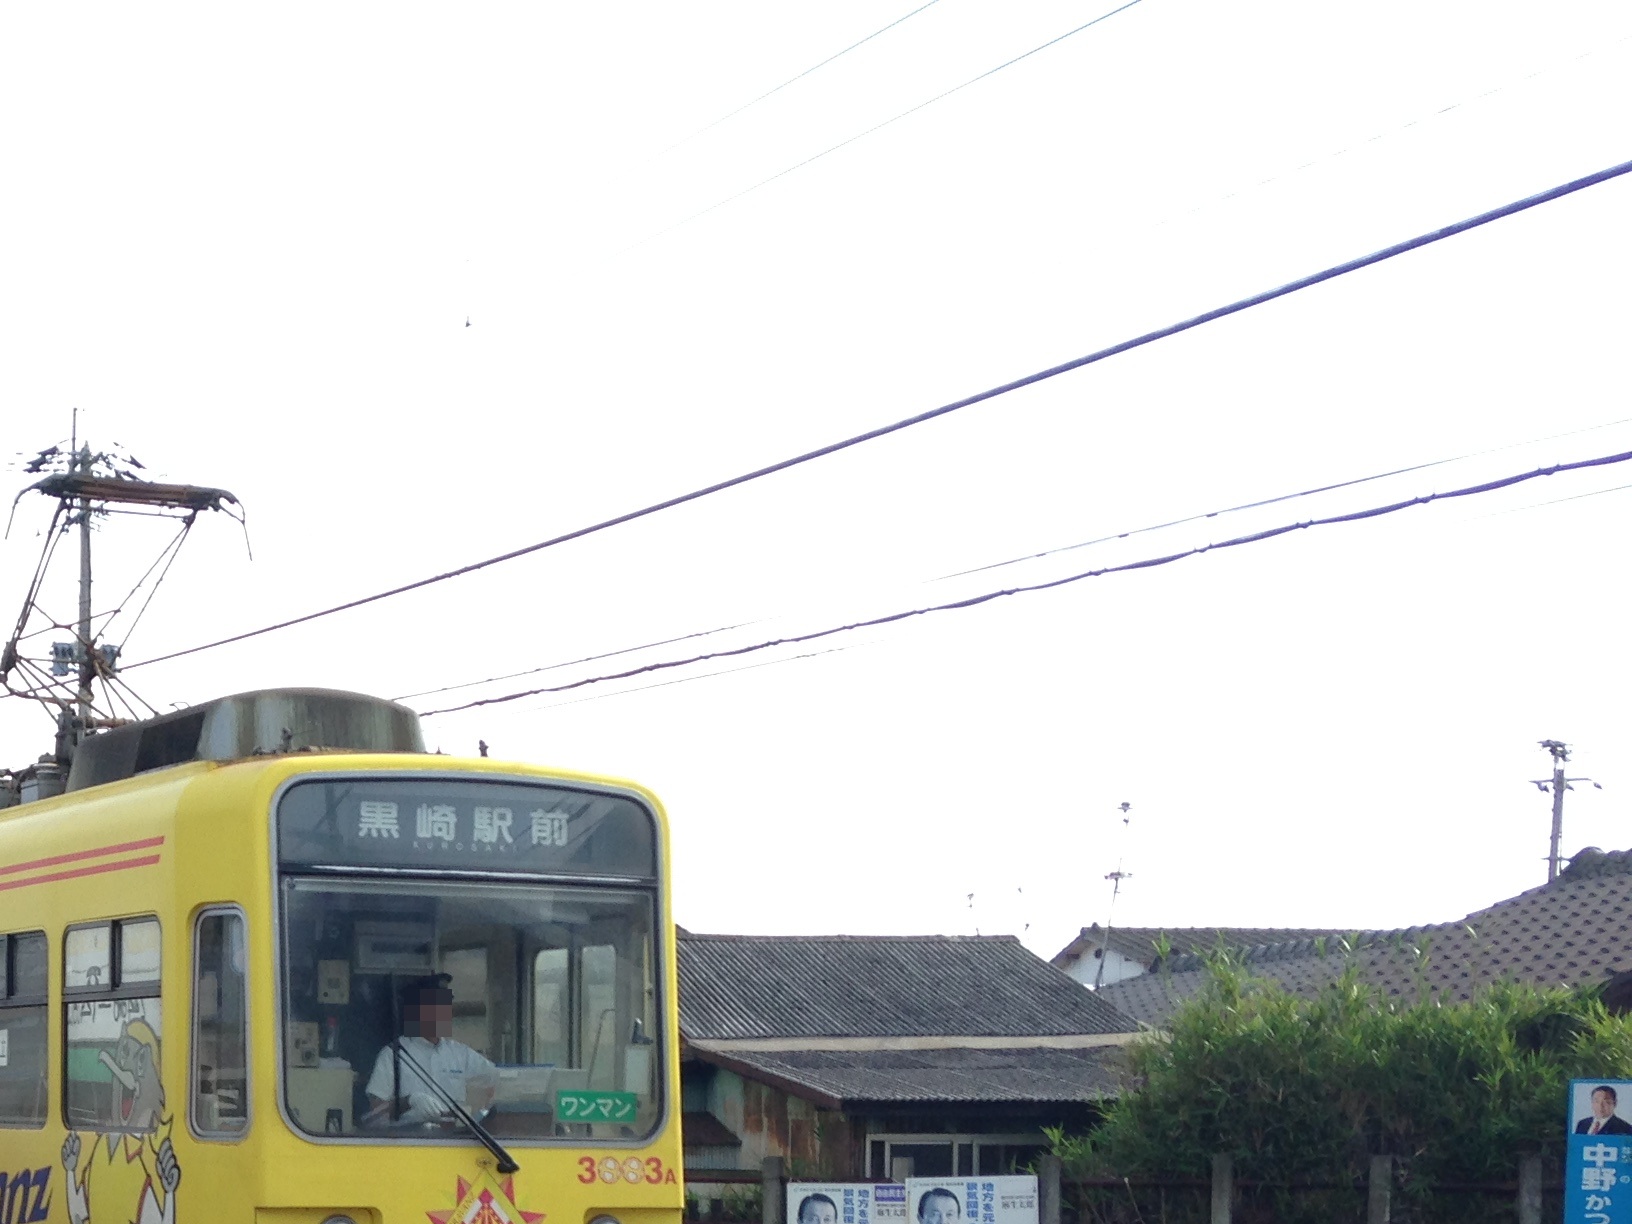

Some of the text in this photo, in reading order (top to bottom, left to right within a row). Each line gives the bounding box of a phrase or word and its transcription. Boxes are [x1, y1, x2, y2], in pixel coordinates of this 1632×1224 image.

[358, 800, 570, 847] 黒崎駅前
[560, 1096, 633, 1119] ワンマン
